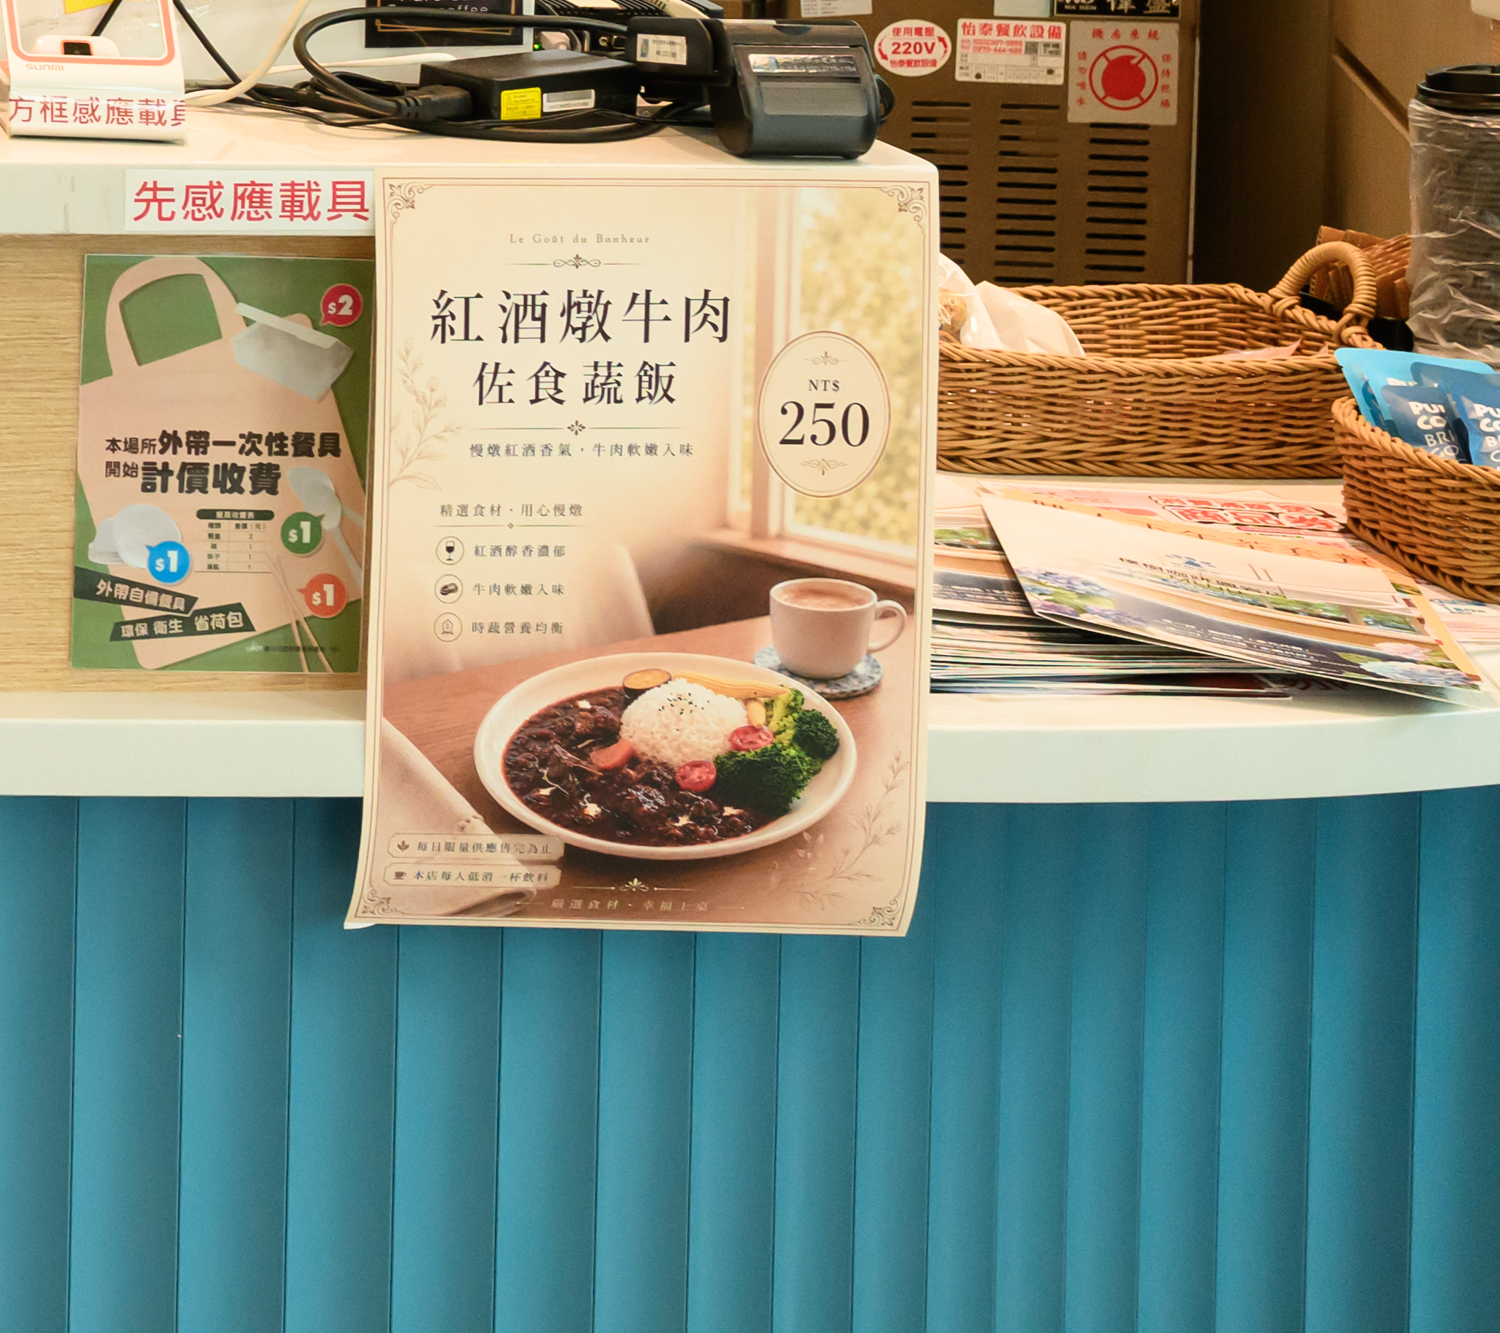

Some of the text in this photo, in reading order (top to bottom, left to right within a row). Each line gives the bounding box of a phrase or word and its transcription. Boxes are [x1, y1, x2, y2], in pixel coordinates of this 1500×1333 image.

[892, 27, 935, 37] 使用電壓
[961, 22, 1062, 40] 怡泰餐飲設備
[891, 42, 936, 55] 220V
[26, 64, 64, 72] SUNMI
[132, 179, 371, 224] 先感應載具
[510, 231, 650, 247] Le Goût du Bonheur
[327, 294, 354, 316] $2
[429, 288, 732, 346] 紅酒燉牛肉
[472, 360, 679, 407] 佐食蔬飯
[808, 377, 841, 393] NT$
[779, 400, 870, 448] 250
[105, 429, 342, 458] 本場所外帶一次性餐具
[469, 442, 694, 459] 慢燉紅酒香氣，牛肉軟嫩入味
[105, 461, 282, 496] 開始計價收費
[288, 521, 312, 544] $1
[155, 549, 180, 573] $1
[474, 543, 566, 559] 紅酒醇香濃郁
[96, 579, 186, 612] 外帶自備餐具
[312, 584, 335, 607] $1
[472, 581, 565, 597] 牛肉軟嫩入味
[121, 611, 244, 638] 環保 衛生 省荷包
[471, 619, 564, 636] 時蔬營養均衡
[416, 839, 553, 857] 每日限量供應售完為止
[412, 868, 549, 885] 本店每人低消一杯飲料
